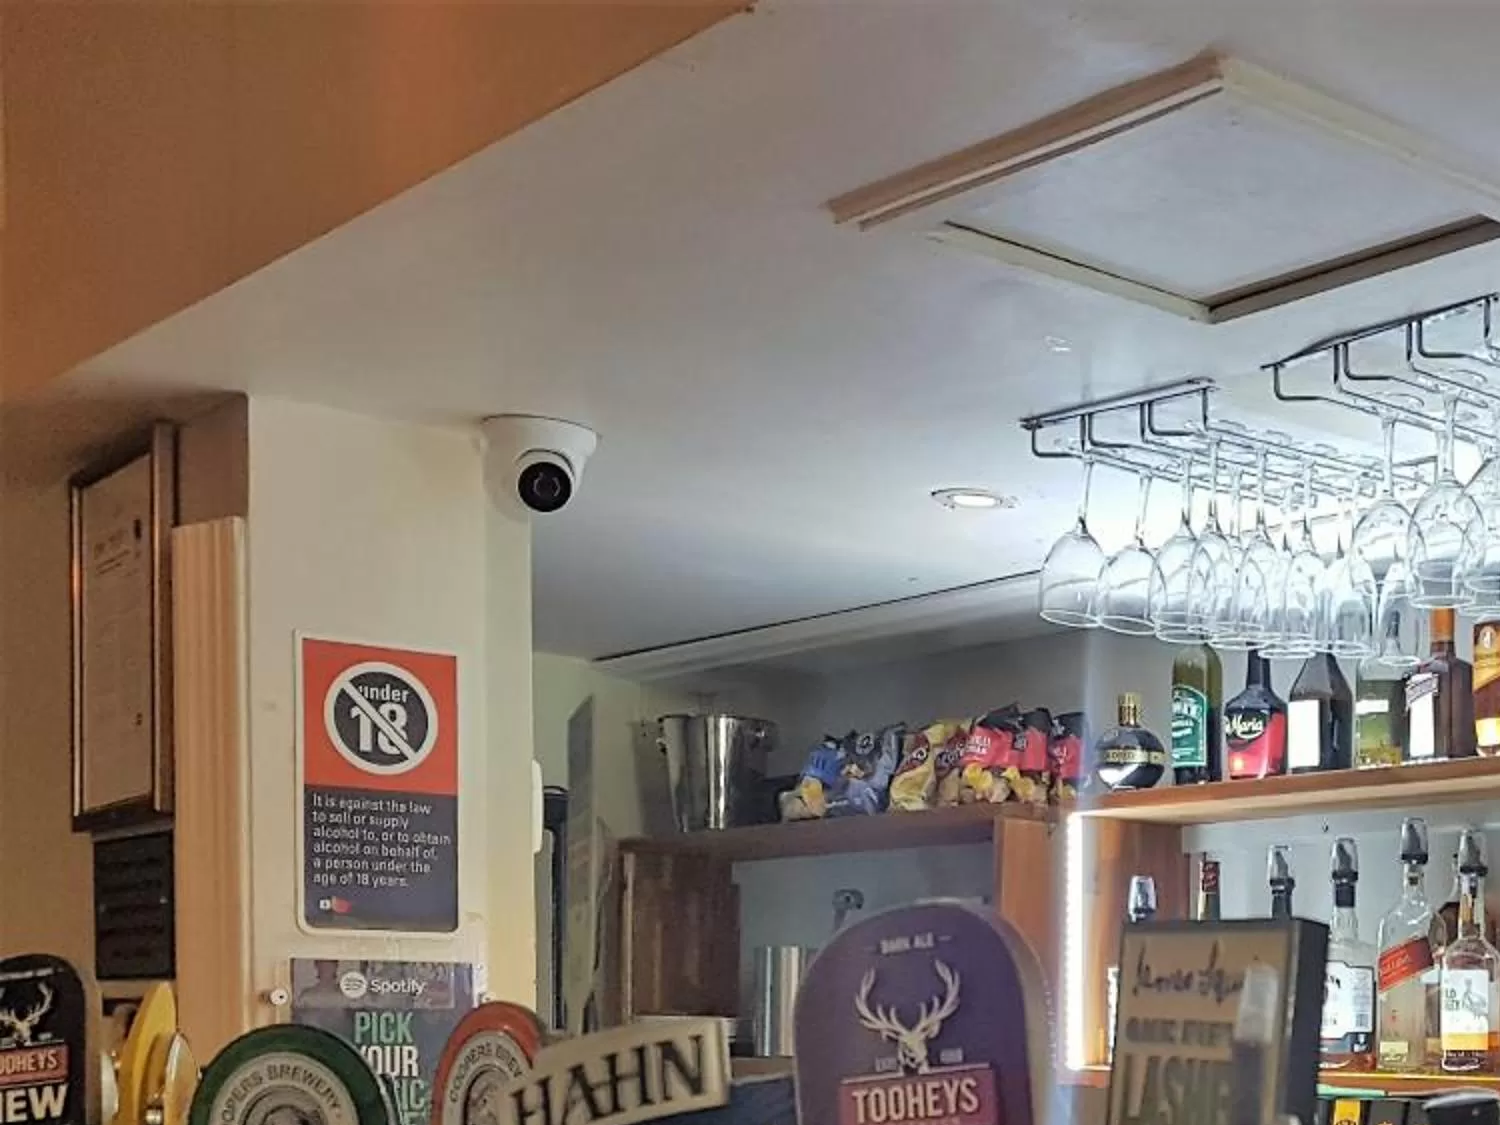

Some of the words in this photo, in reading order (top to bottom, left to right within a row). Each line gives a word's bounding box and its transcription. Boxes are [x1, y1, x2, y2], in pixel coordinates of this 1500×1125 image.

[357, 682, 410, 703] under
[350, 701, 408, 756] 18
[312, 793, 322, 808] It
[325, 794, 335, 808] is
[340, 796, 383, 812] against
[386, 799, 407, 813] the
[409, 800, 432, 815] law
[312, 811, 327, 823] to
[353, 814, 366, 825] or
[369, 814, 409, 830] supply
[313, 825, 359, 839] alcohol
[381, 831, 395, 842] or
[397, 831, 409, 843] to
[412, 832, 451, 846] obtain
[313, 840, 360, 855] alcohol
[363, 845, 379, 856] on
[381, 844, 420, 860] behalf
[312, 858, 322, 869] a
[325, 859, 369, 873] person
[371, 860, 408, 873] under
[411, 860, 432, 874] the
[312, 873, 338, 887] age
[339, 873, 353, 886] of
[356, 873, 370, 886] 18
[370, 978, 428, 997] Spotify
[354, 1011, 415, 1045] PICK
[266, 1063, 341, 1110] BREWERY
[0, 1083, 69, 1124] EW
[851, 1076, 980, 1125] TOOHEYS
